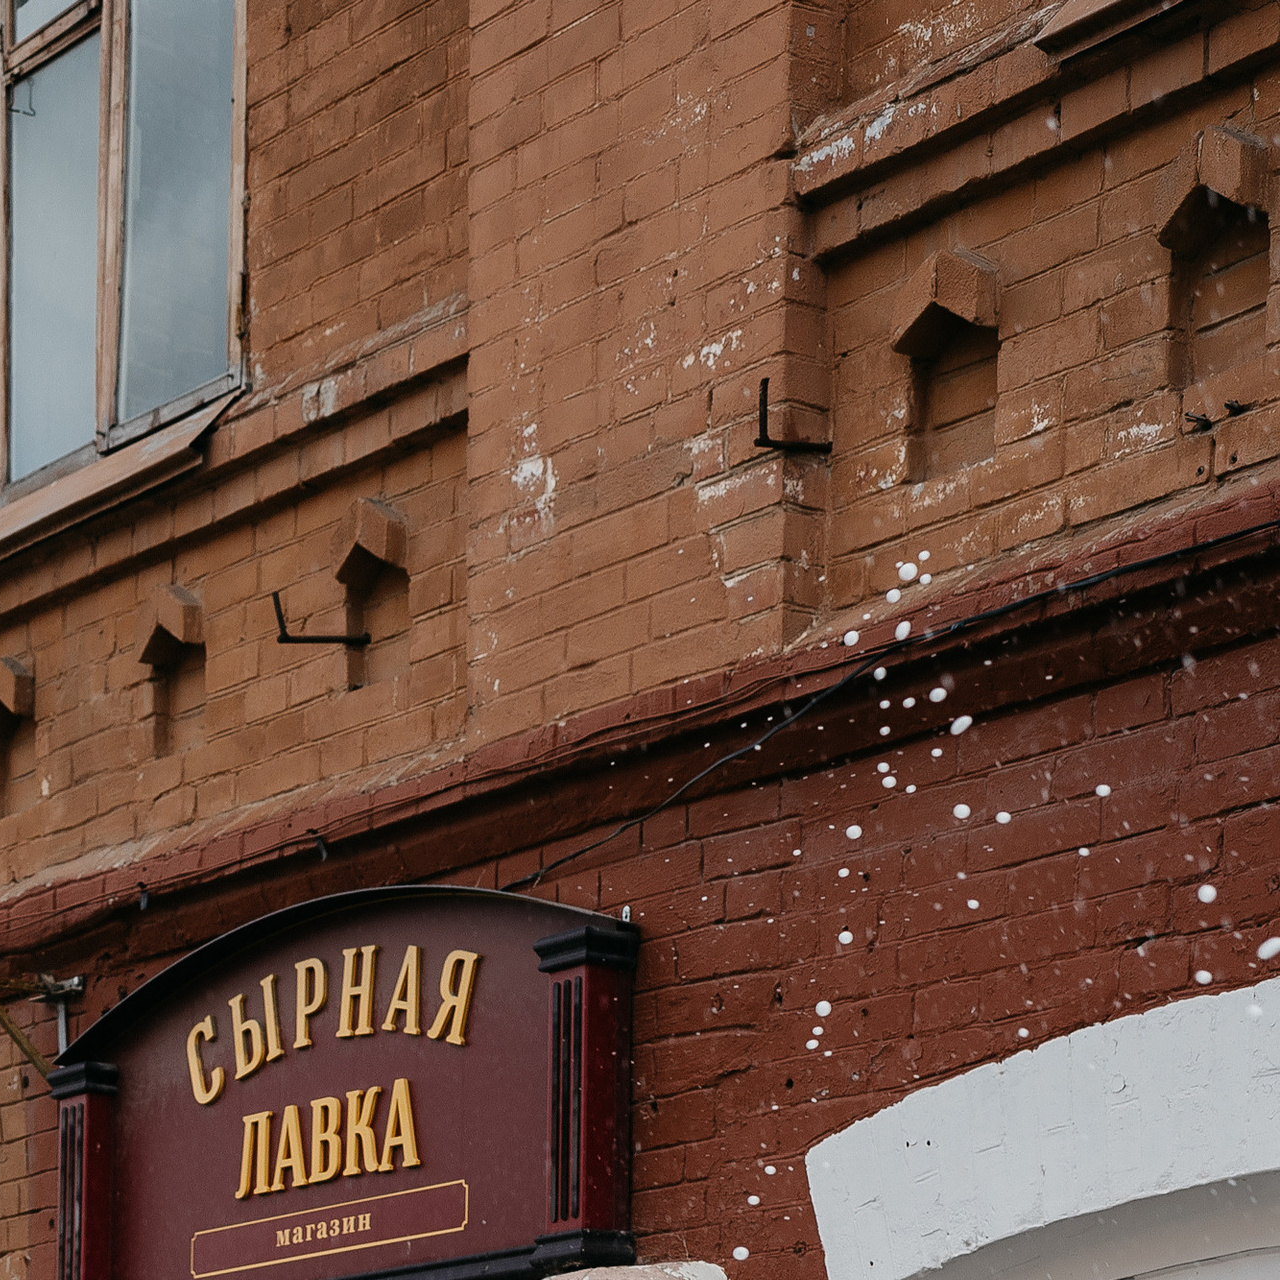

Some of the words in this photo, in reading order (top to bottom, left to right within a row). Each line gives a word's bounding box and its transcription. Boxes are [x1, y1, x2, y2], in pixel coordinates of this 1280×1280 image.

[186, 945, 482, 1105] СЫРНАЯ
[235, 1078, 420, 1199] ЛАВКА
[276, 1213, 371, 1247] магазин
